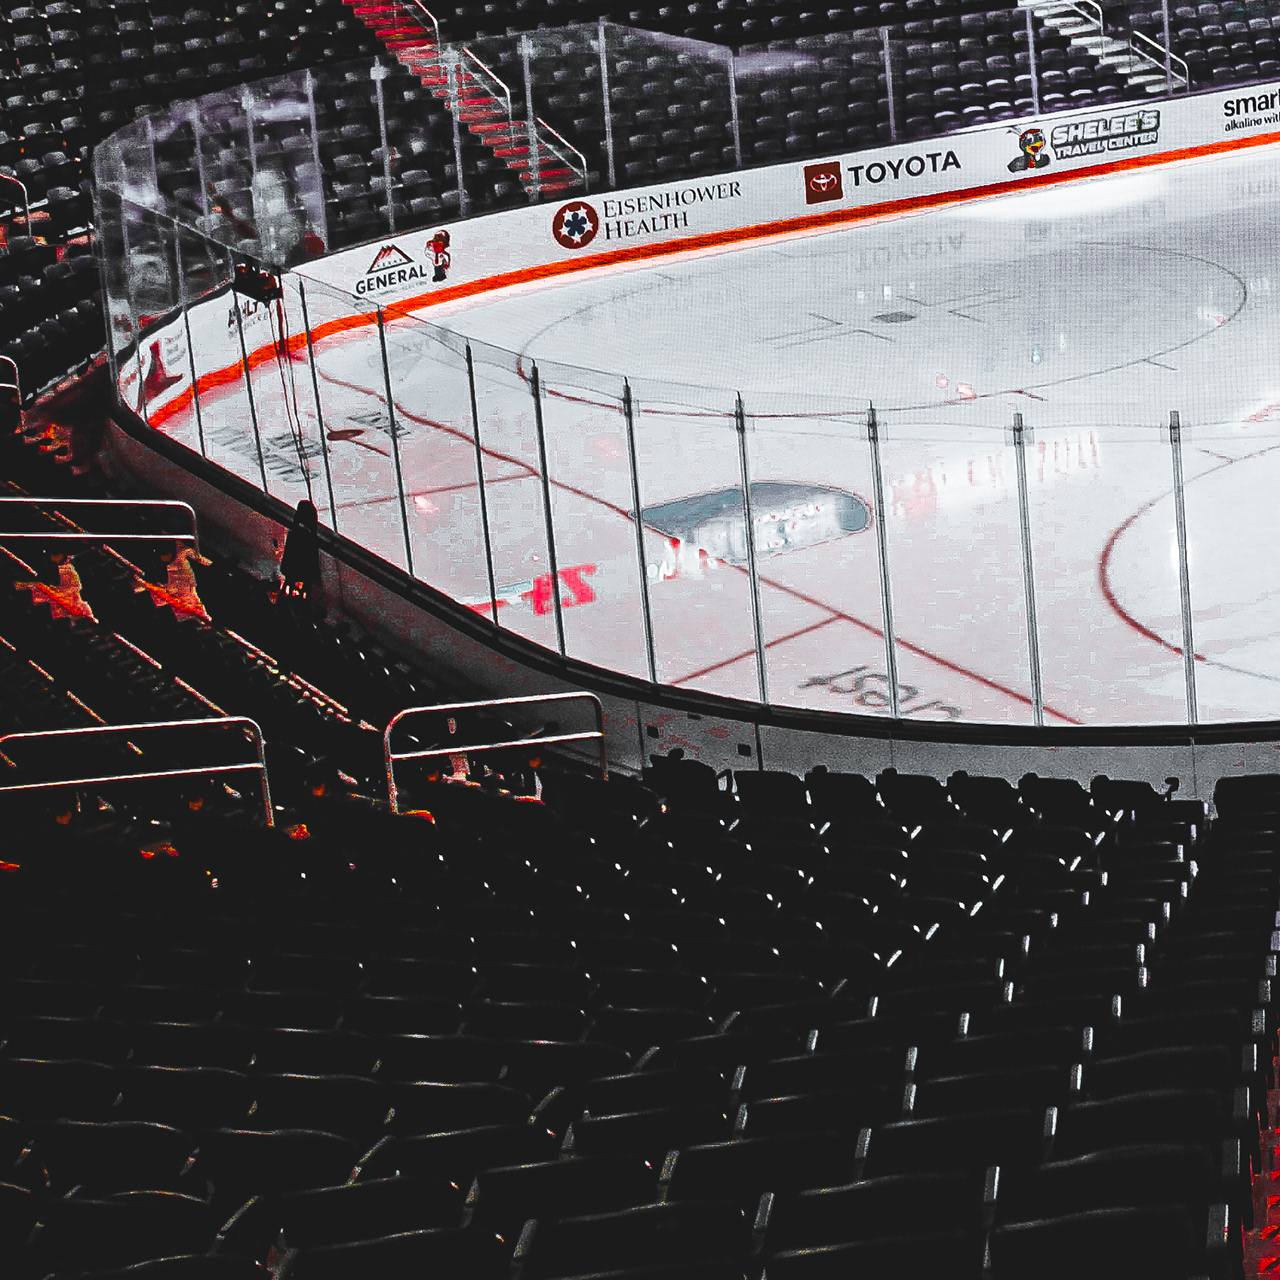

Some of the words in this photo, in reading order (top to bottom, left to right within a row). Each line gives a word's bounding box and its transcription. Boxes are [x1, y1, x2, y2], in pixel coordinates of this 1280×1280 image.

[1054, 141, 1105, 160] TRAVEL
[1107, 132, 1158, 151] CENTER
[848, 151, 962, 187] TOYOTA
[603, 180, 742, 218] EISENHOWER
[603, 211, 689, 241] HEALTH
[355, 264, 428, 295] GENERAL
